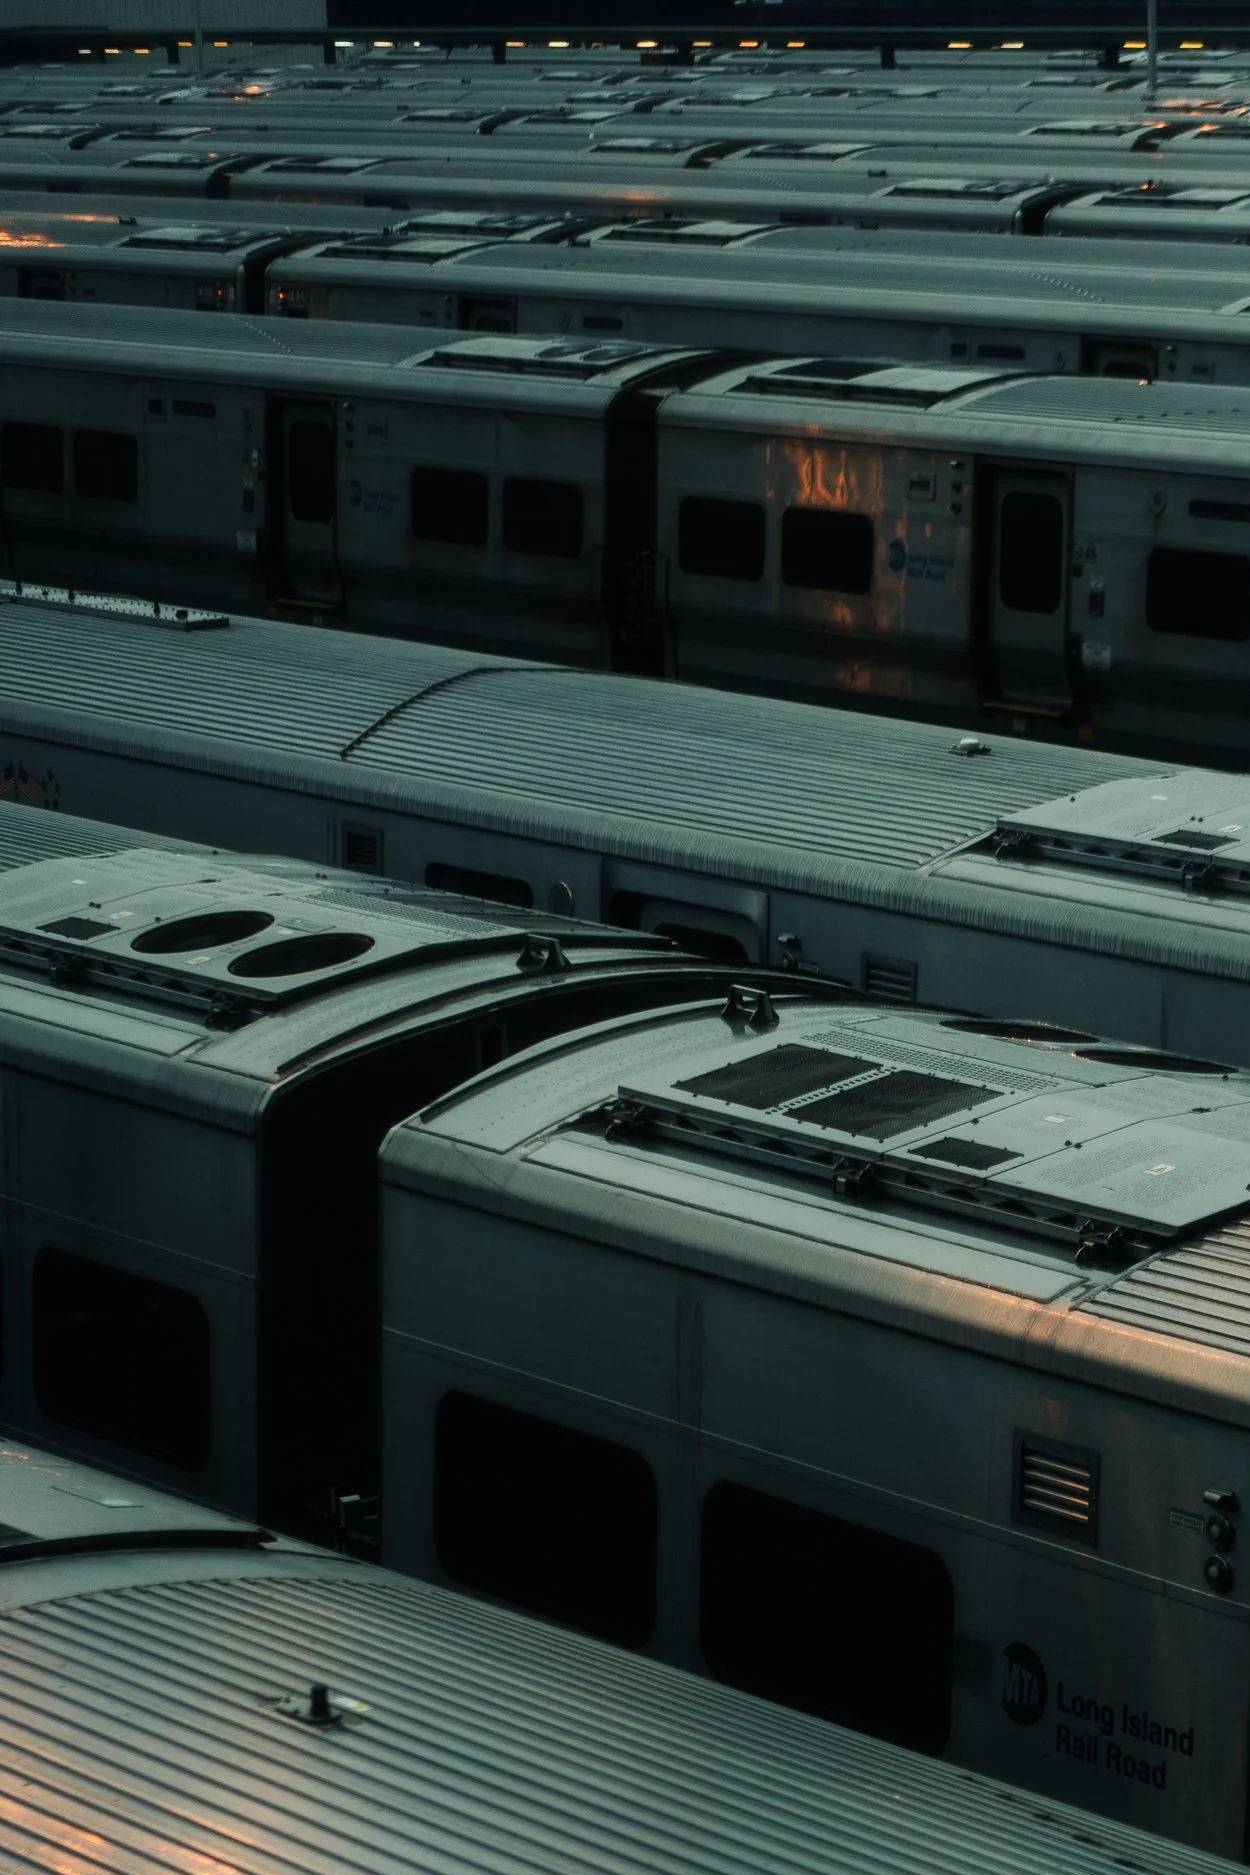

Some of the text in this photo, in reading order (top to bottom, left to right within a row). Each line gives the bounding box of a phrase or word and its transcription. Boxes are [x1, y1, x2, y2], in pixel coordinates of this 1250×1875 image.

[1057, 1682, 1194, 1756] Long Island
[1056, 1723, 1167, 1789] Rail Road
